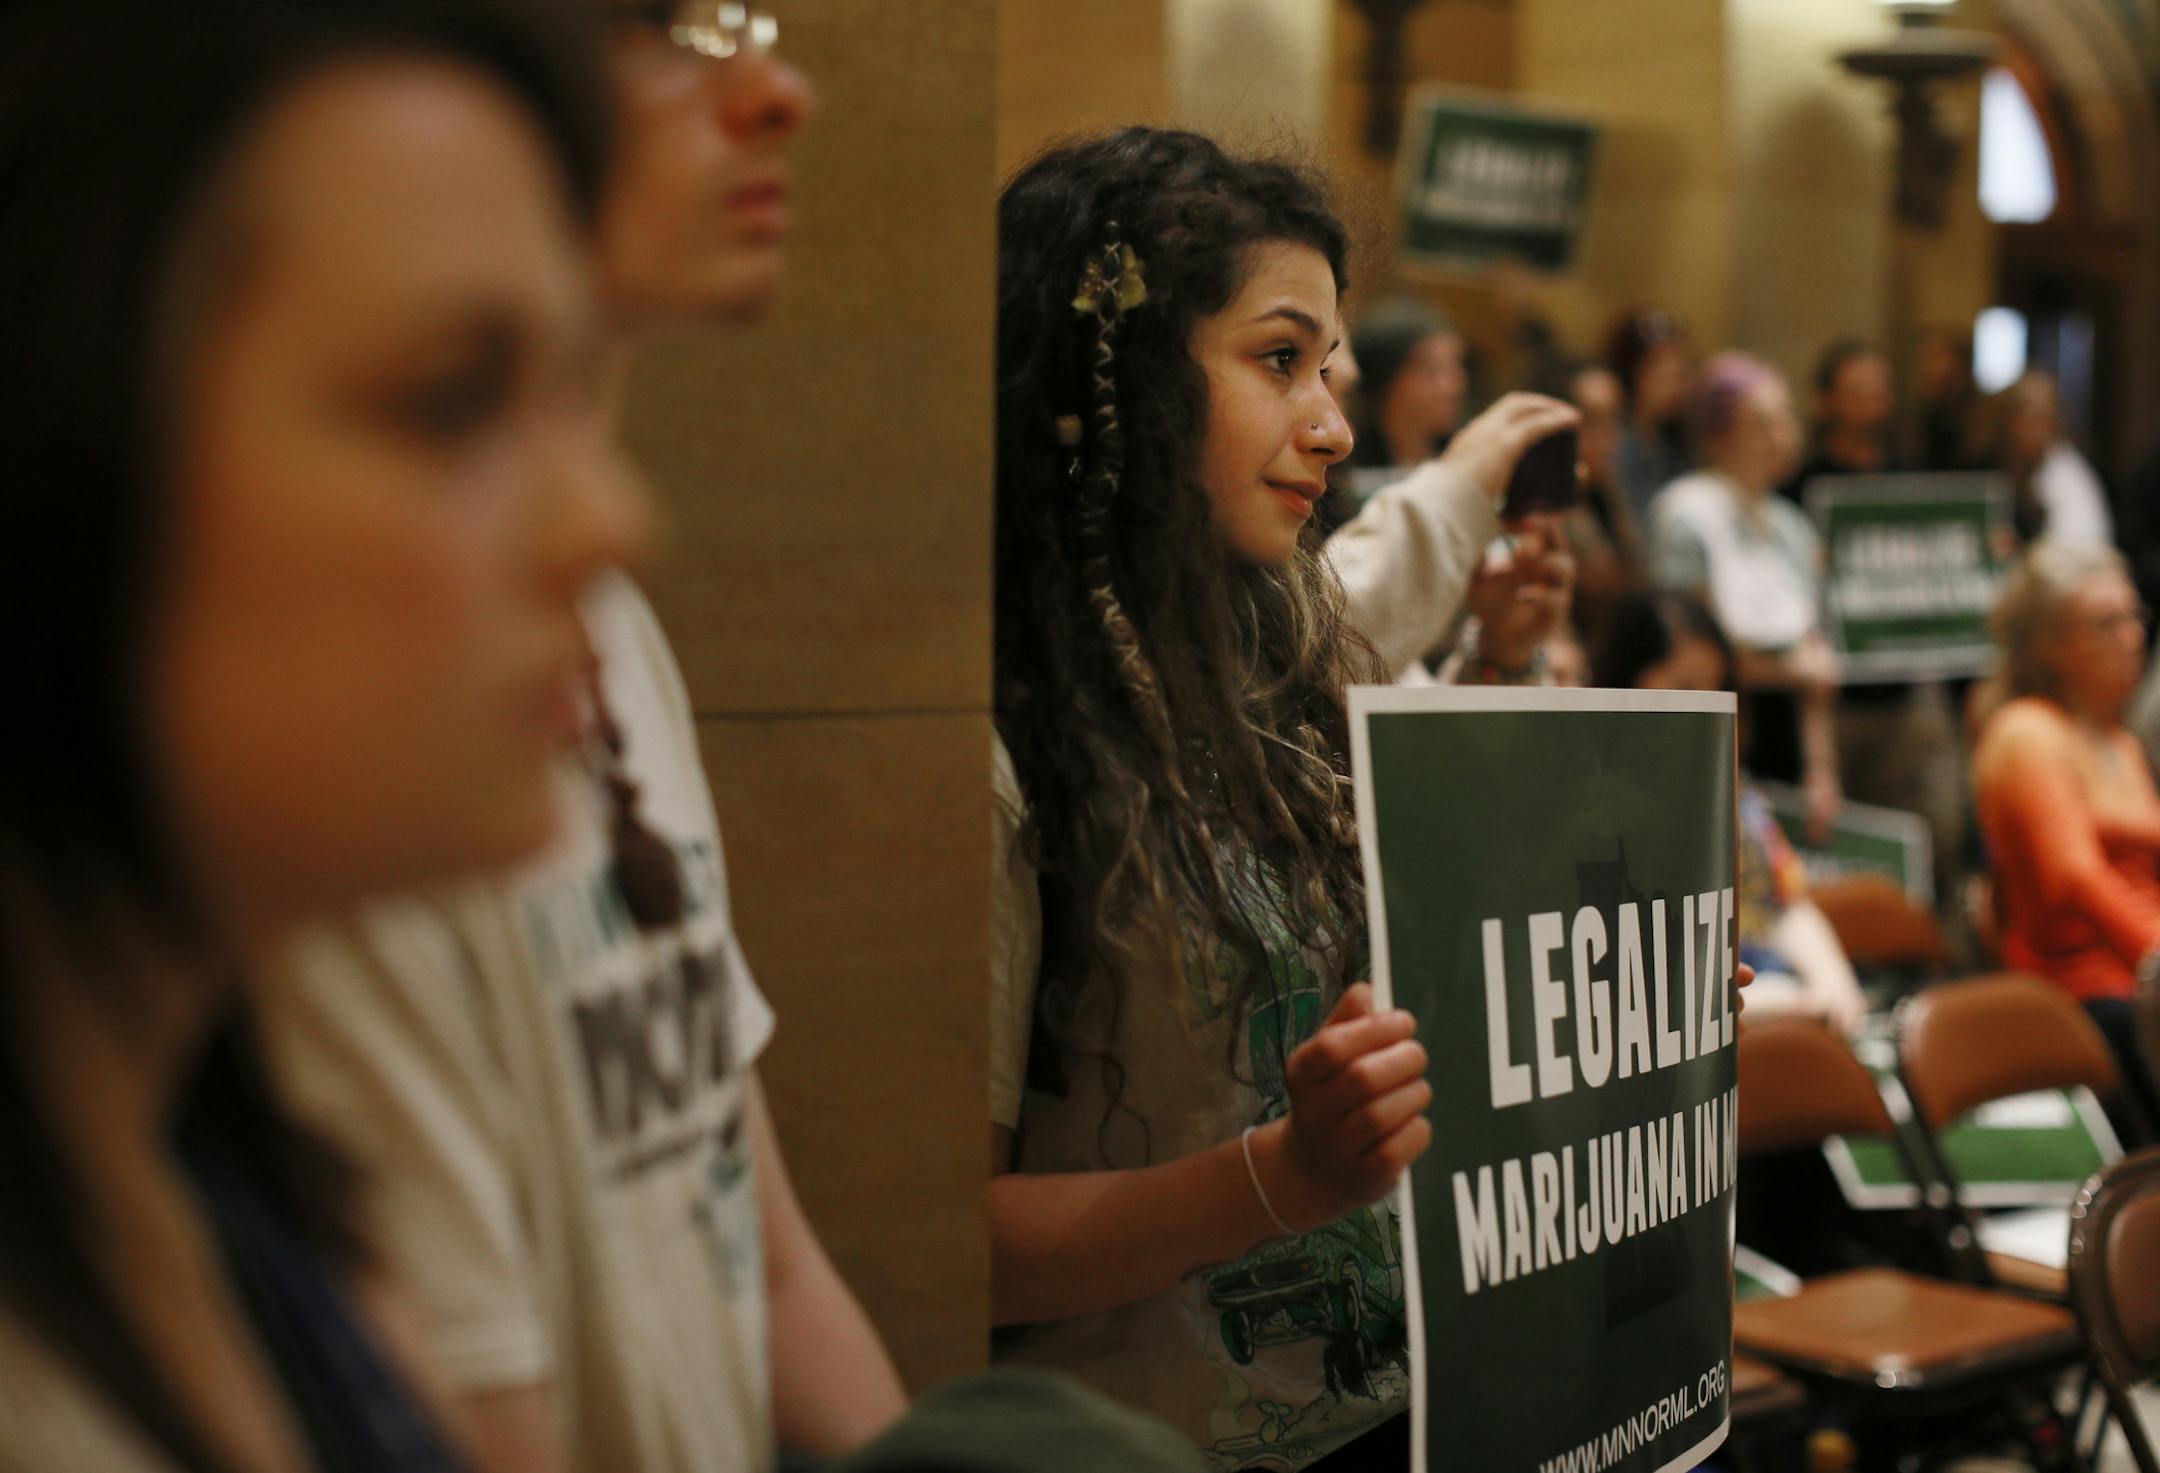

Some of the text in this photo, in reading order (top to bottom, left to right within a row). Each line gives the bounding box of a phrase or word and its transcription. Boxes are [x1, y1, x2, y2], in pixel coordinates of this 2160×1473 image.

[1482, 887, 1734, 1109] LEGALIZE
[1452, 1110, 1688, 1295] MARIJUANA
[1695, 1097, 1718, 1208] IN
